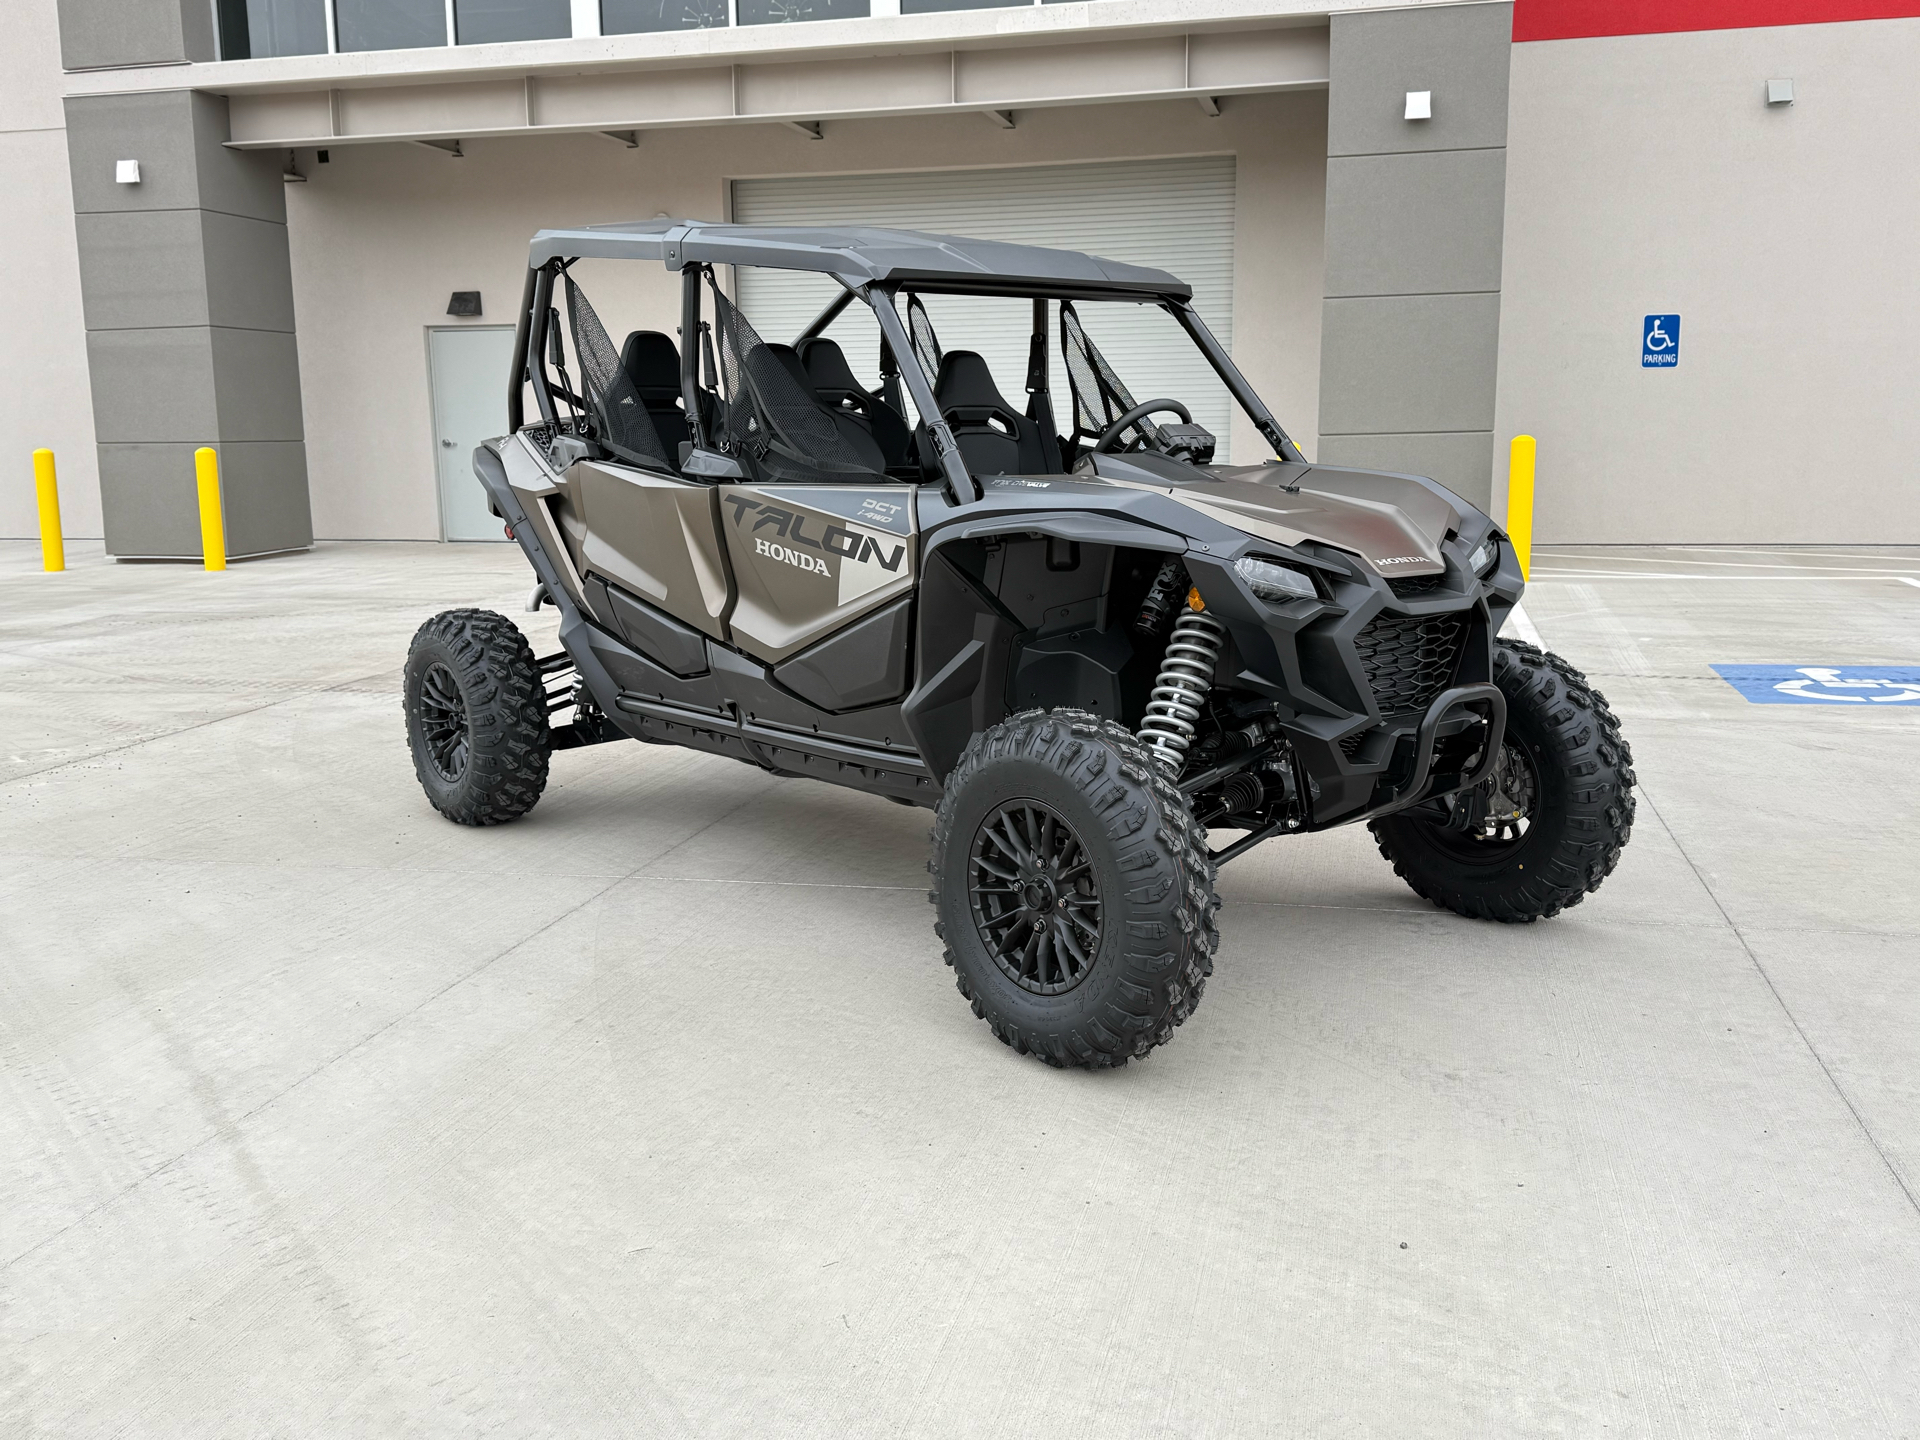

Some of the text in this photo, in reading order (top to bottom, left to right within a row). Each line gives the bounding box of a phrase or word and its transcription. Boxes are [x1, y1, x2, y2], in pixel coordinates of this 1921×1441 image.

[1643, 353, 1676, 363] PARKING
[861, 498, 902, 515] DCT
[724, 494, 906, 573] TALON
[754, 538, 831, 578] HONDA
[1373, 556, 1431, 566] HONDA
[1147, 562, 1177, 601] FOX
